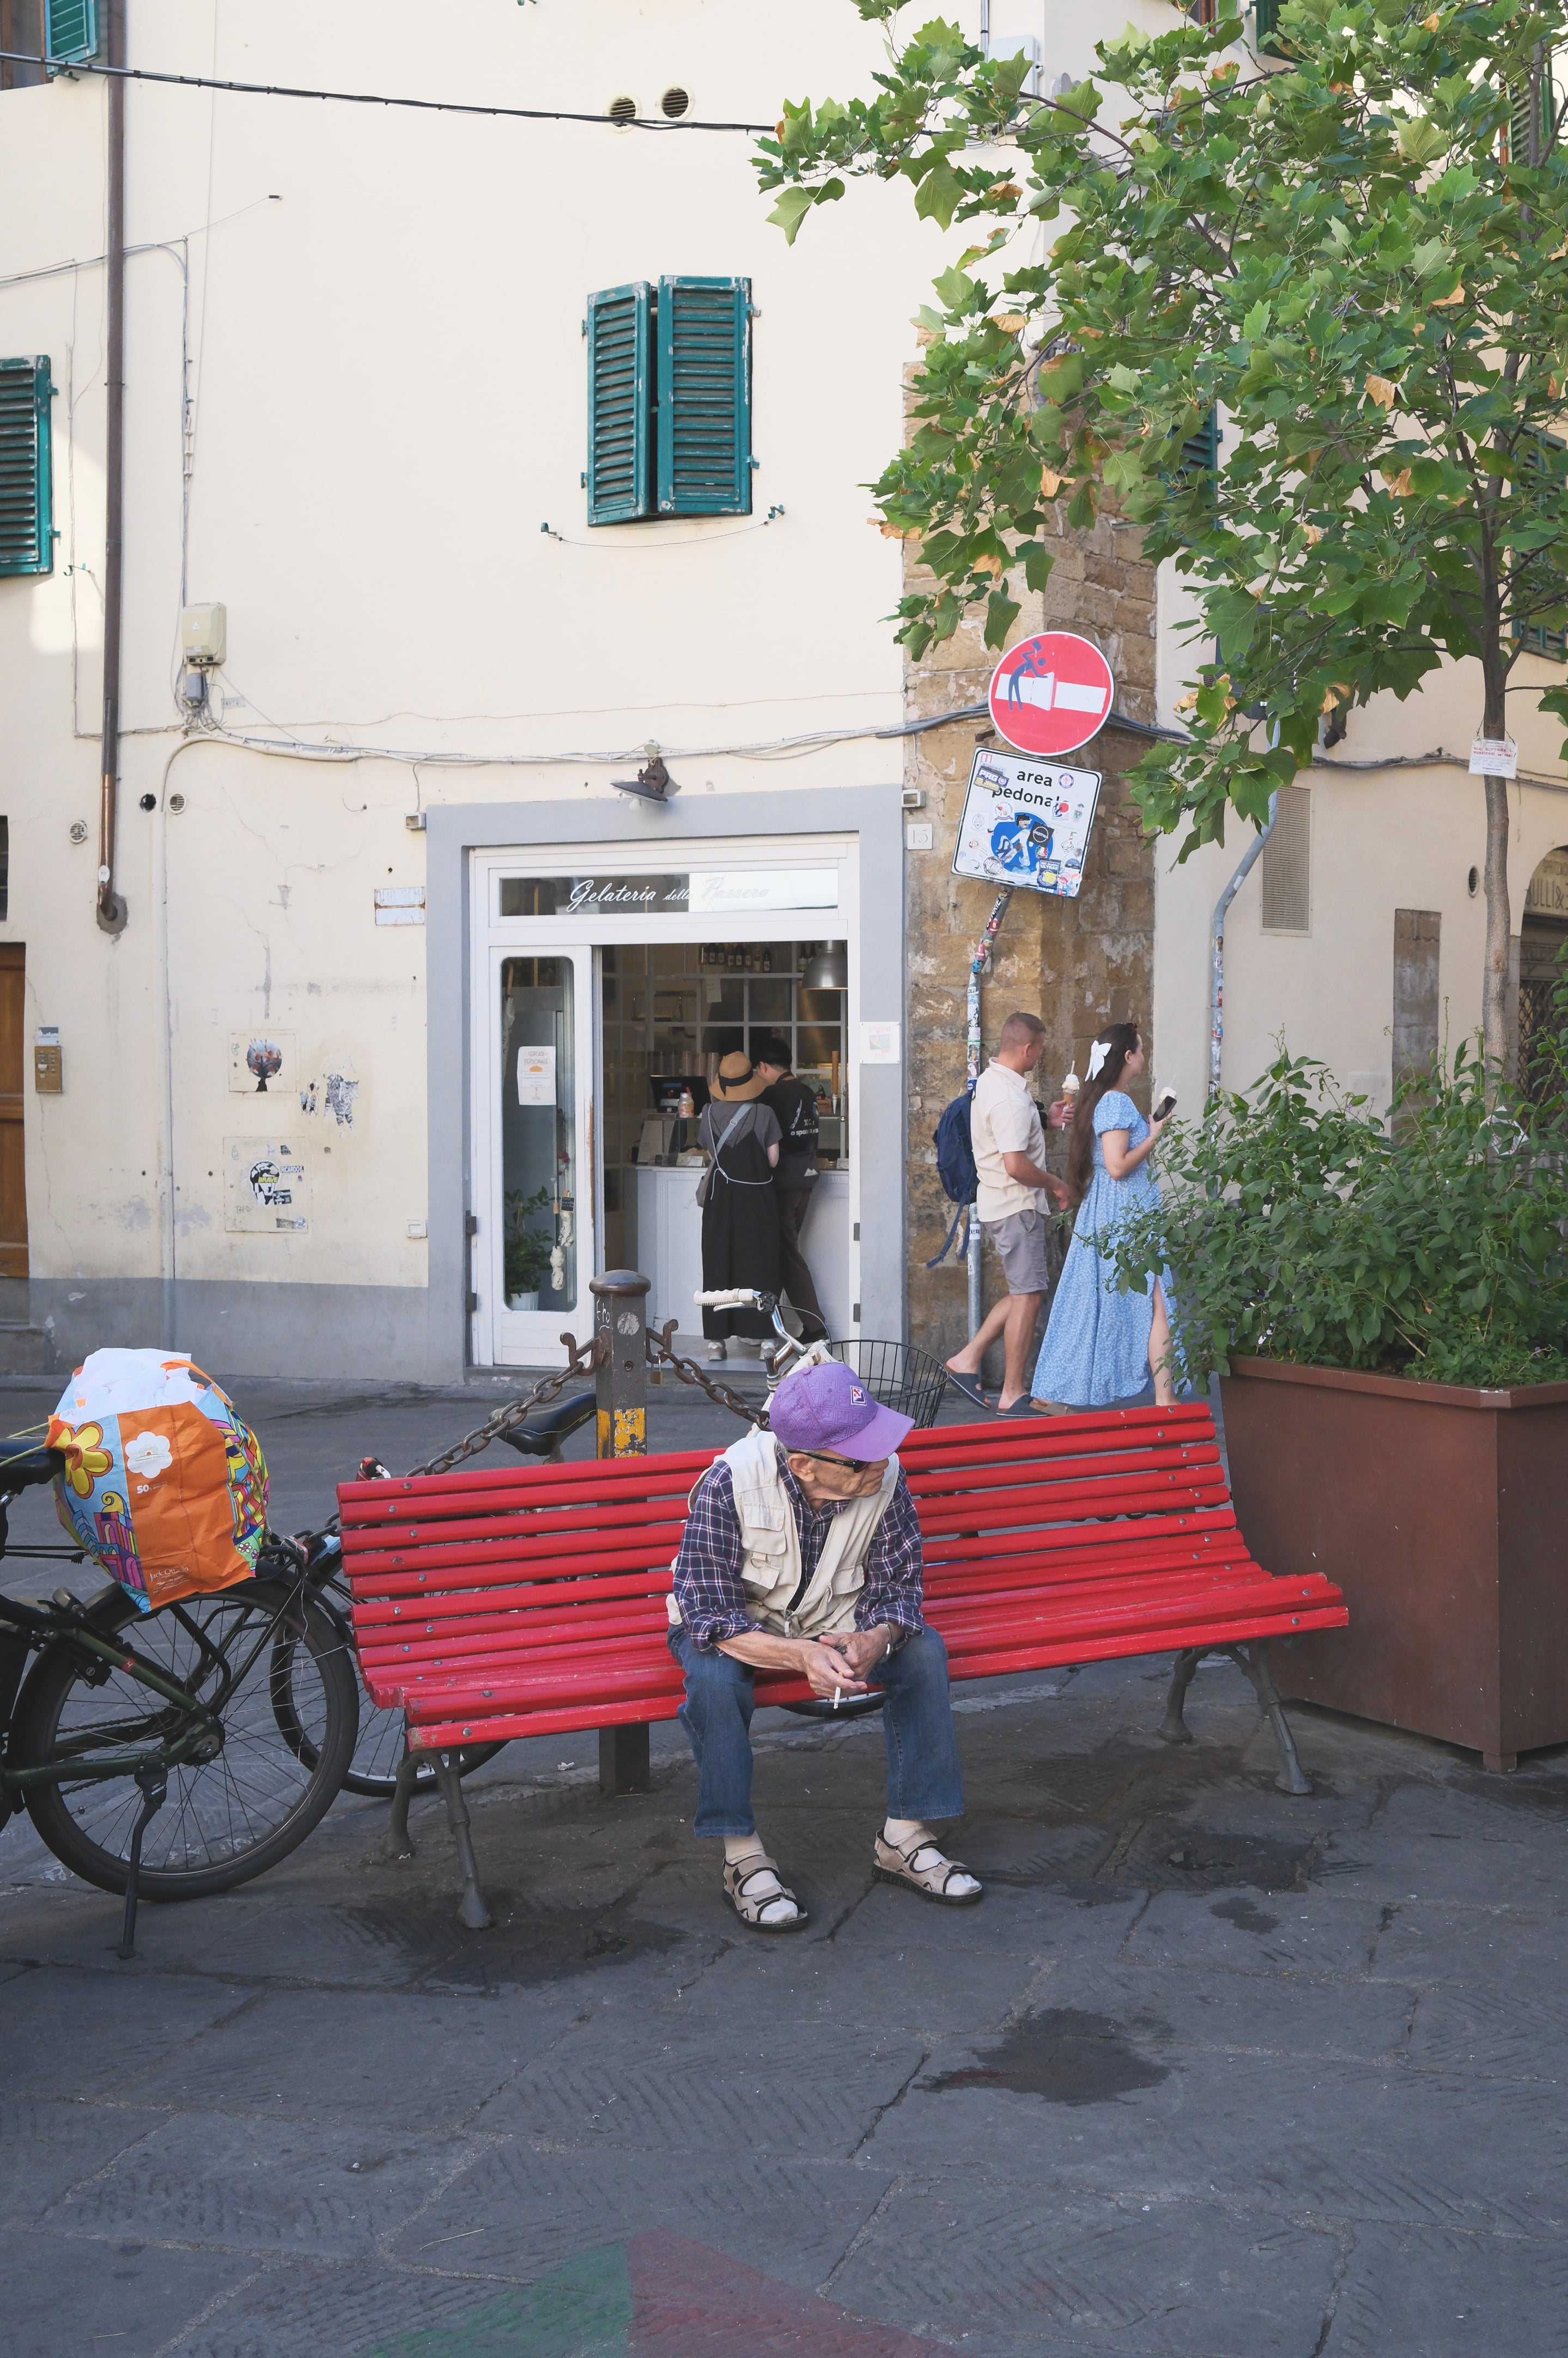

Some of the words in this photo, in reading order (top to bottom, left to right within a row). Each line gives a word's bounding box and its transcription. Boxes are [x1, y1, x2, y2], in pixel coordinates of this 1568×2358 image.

[1017, 770, 1053, 787] area
[992, 788, 1069, 807] pedona
[913, 829, 928, 844] 15
[566, 879, 657, 912] Gelateria
[663, 889, 694, 901] della
[150, 1570, 163, 1583] Jack
